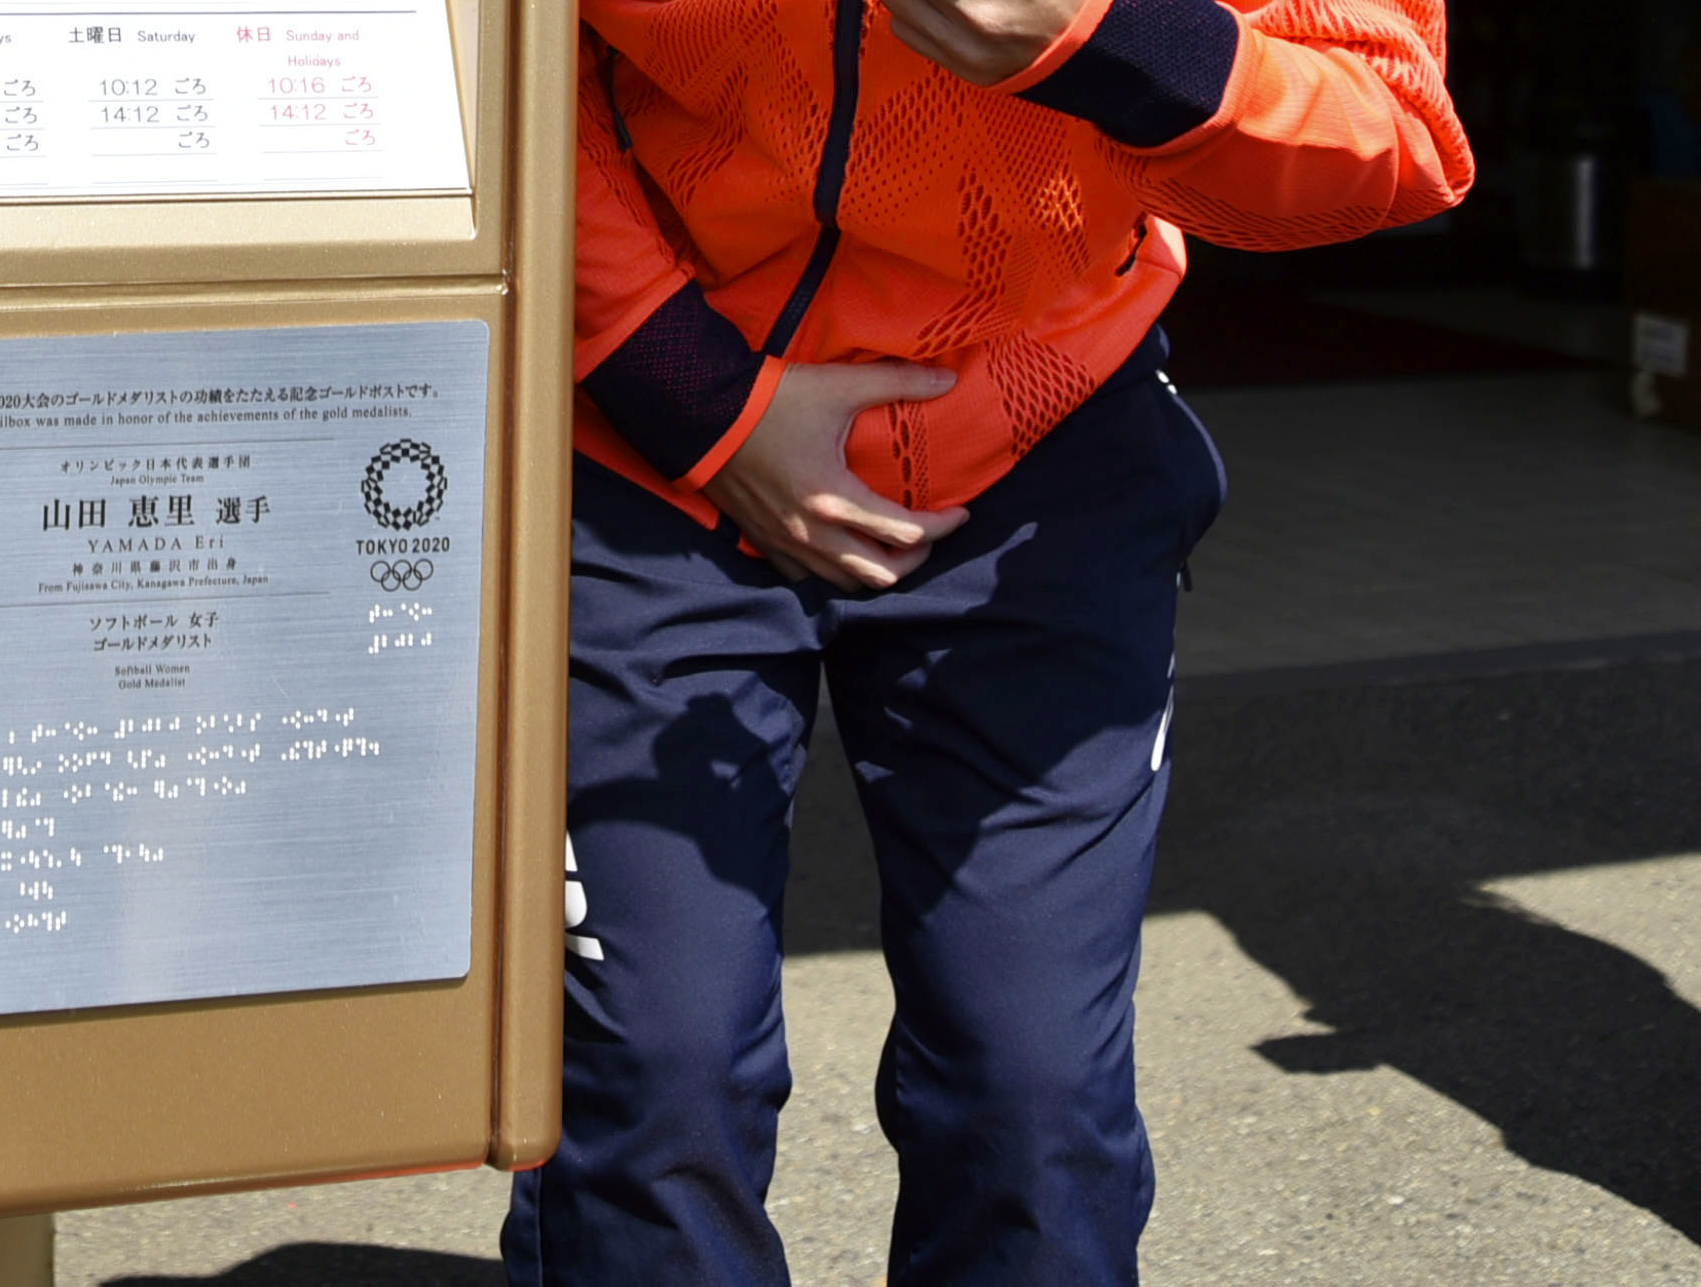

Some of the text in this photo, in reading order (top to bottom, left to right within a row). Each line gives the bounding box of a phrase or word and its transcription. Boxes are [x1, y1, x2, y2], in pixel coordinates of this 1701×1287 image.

[68, 26, 123, 44] 土曜日
[137, 30, 196, 44] Saturday
[236, 26, 272, 43] 休日
[286, 30, 333, 43] Sunday
[336, 30, 360, 42] and
[287, 55, 342, 68] Holidays
[2, 79, 37, 97] ごろ
[99, 79, 159, 97] 10:12
[174, 78, 207, 96] ごろ
[268, 77, 326, 95] 10:16
[340, 76, 372, 94] ごろ
[4, 106, 38, 125] ごろ
[100, 106, 160, 123] 14:12
[176, 104, 209, 122] ごろ
[270, 103, 327, 121] 14:12
[343, 102, 374, 120] ごろ
[6, 134, 39, 152] ごろ
[178, 132, 211, 149] ごろ
[345, 129, 376, 147] ごろ
[36, 417, 60, 427] was
[64, 414, 97, 426] made
[101, 413, 114, 425] in
[118, 412, 154, 425] honor
[157, 411, 172, 424] of
[174, 410, 193, 423] the
[197, 409, 279, 422] achievements
[283, 408, 299, 420] of
[300, 408, 319, 420] the
[322, 407, 349, 421] gold
[42, 494, 271, 531] 山田 恵里 選手
[88, 534, 226, 553] YAMADA Eri
[355, 536, 451, 556] TOKYO 2020
[89, 611, 220, 632] ソフトボール 女子
[93, 633, 214, 652] ゴールドメダリスト
